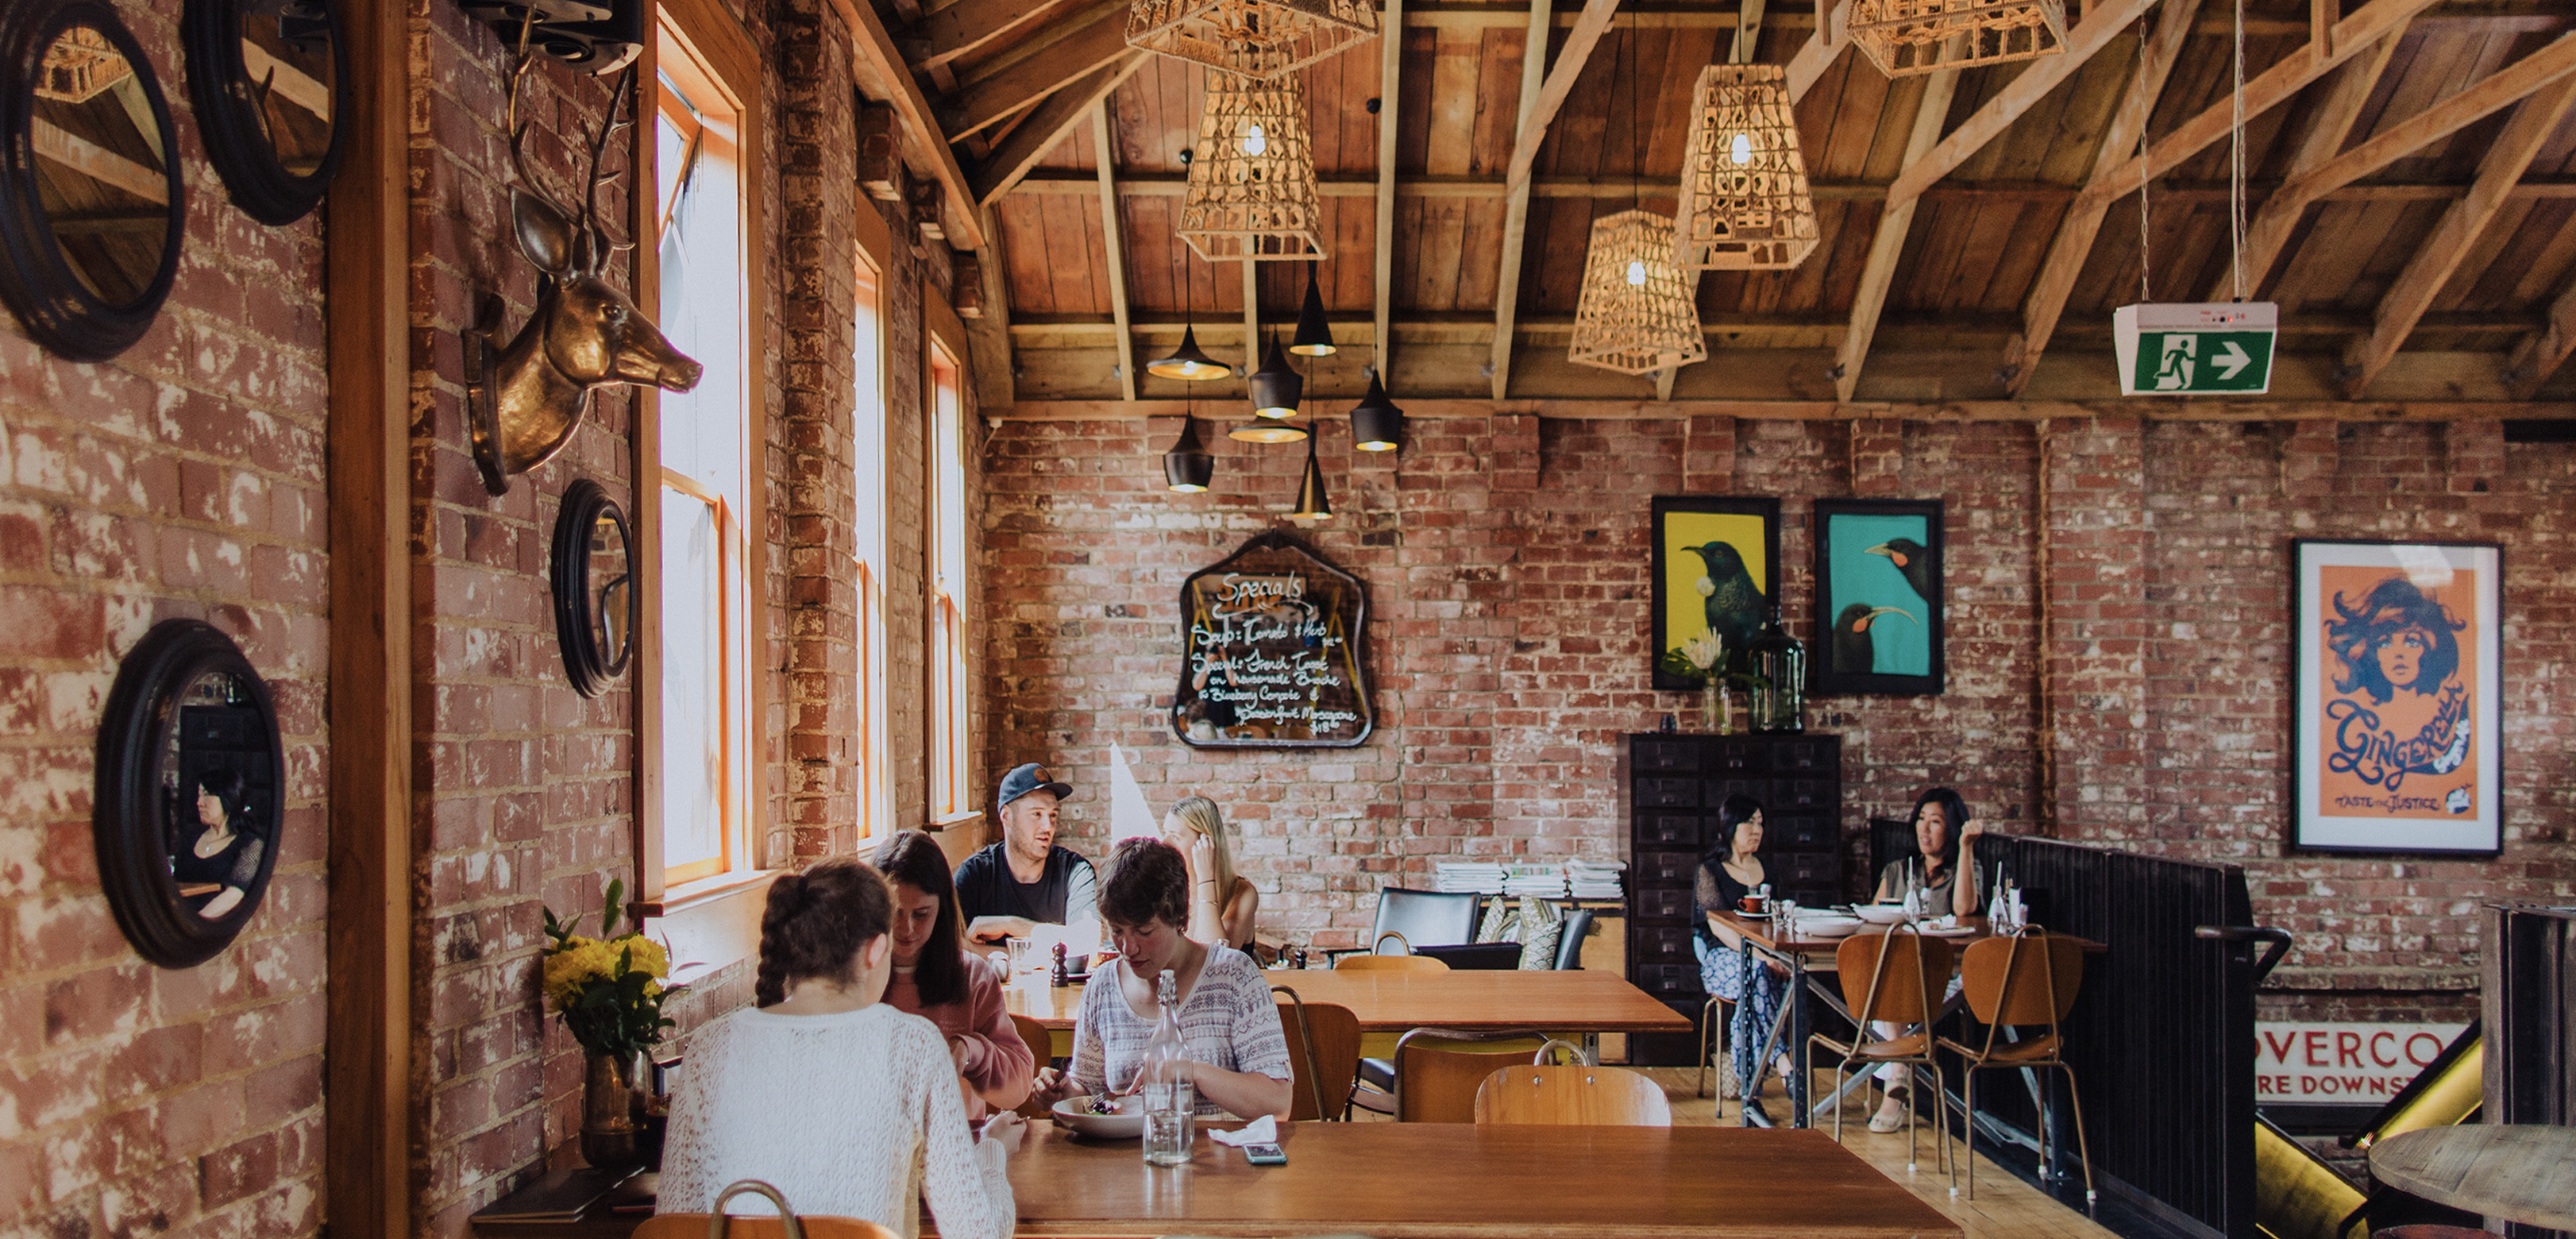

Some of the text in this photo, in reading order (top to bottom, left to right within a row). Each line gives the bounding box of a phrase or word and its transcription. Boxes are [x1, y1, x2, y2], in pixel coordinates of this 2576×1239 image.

[1217, 571, 1302, 605] Specials
[1191, 616, 1242, 648] Soup:
[1243, 616, 1289, 646] Tomato
[1191, 648, 1329, 674] Special: French Toast
[1209, 677, 1227, 685] on
[1209, 688, 1259, 709] Blueberry
[1259, 685, 1301, 704] Compote
[1234, 704, 1300, 725] Passionfruit
[2335, 795, 2373, 808] TASTE
[2388, 794, 2440, 813] JUSTICE
[2255, 1031, 2443, 1068] VERCO
[2301, 1075, 2414, 1095] DOWNS
